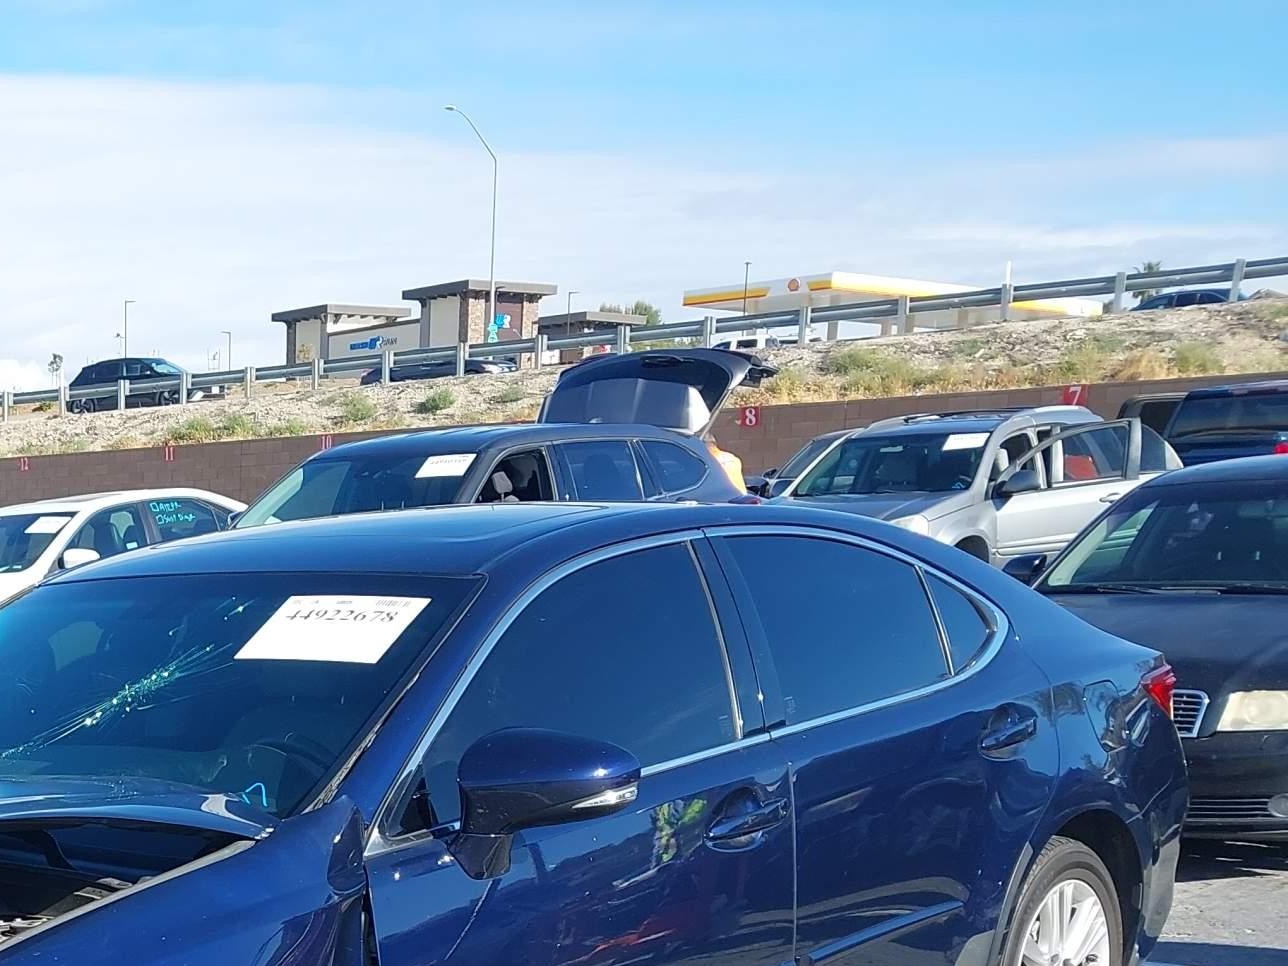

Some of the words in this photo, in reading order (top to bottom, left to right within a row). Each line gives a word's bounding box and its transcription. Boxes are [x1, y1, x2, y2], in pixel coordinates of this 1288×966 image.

[1069, 386, 1082, 405] 7
[745, 407, 756, 426] 8
[165, 446, 174, 461] 11
[285, 609, 399, 622] 44922678
